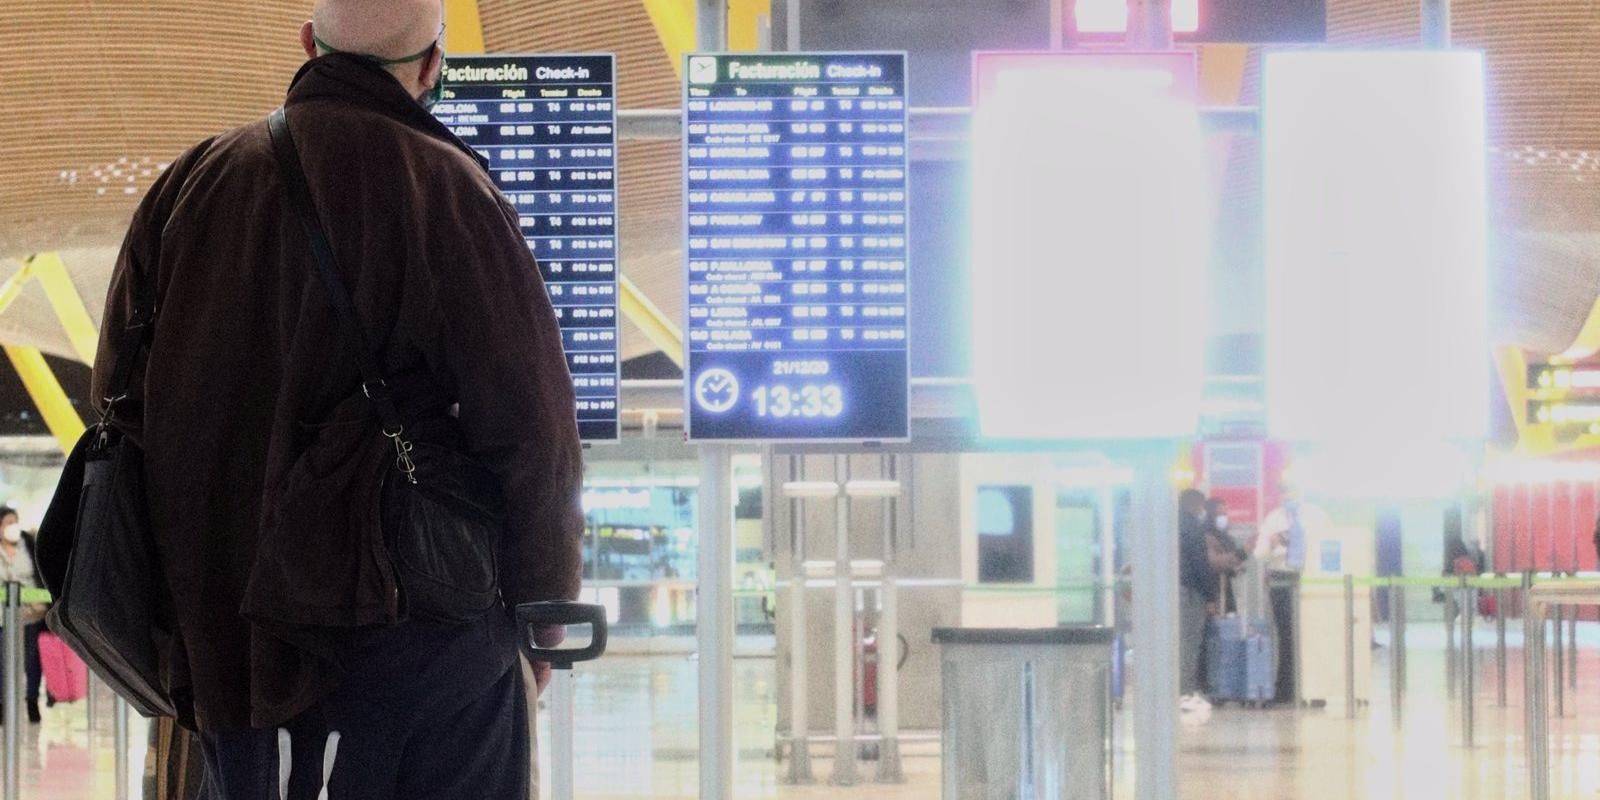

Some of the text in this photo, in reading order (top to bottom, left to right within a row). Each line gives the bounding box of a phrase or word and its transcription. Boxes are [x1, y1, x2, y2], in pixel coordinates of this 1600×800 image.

[536, 67, 590, 80] Check-in
[729, 62, 882, 79] Facturación Check-in
[752, 384, 843, 418] 13:33
